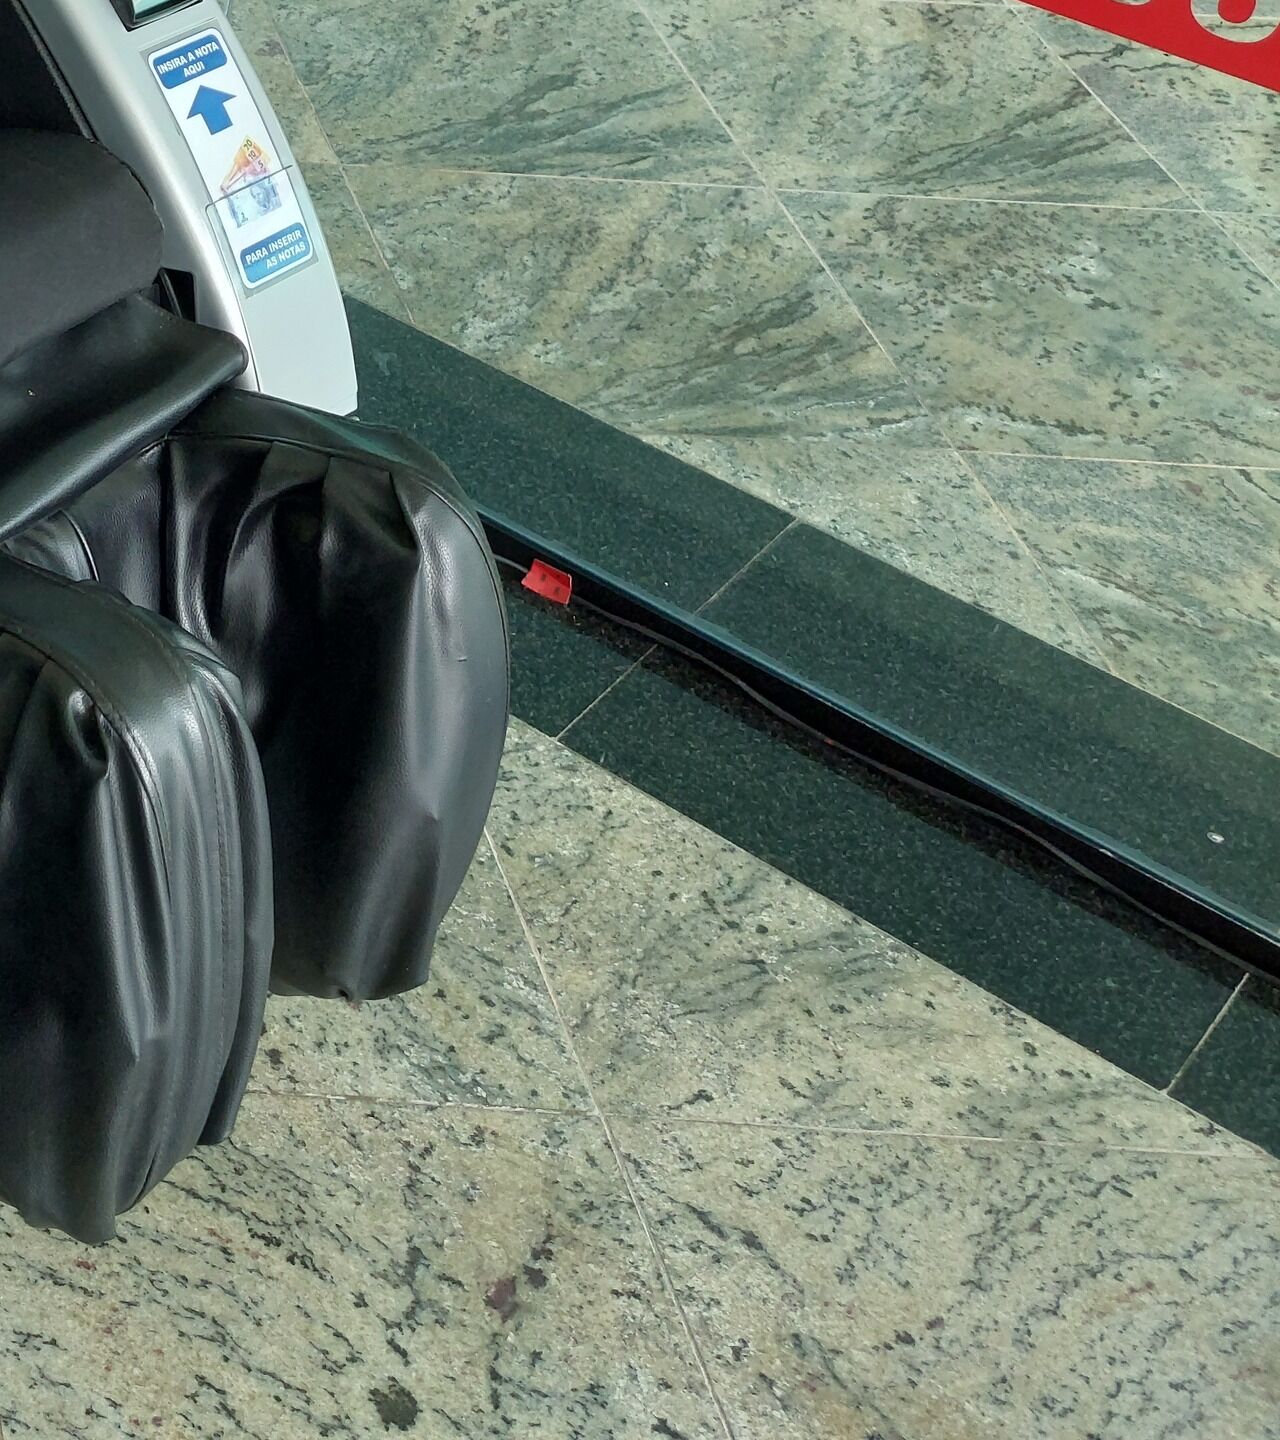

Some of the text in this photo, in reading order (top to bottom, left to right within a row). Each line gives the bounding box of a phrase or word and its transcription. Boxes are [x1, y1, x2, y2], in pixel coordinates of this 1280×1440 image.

[157, 41, 219, 75] INSIRA A NOTA
[183, 61, 205, 77] AQUI
[245, 229, 302, 266] PARA INSERIR
[266, 241, 306, 270] AS NOTAS
